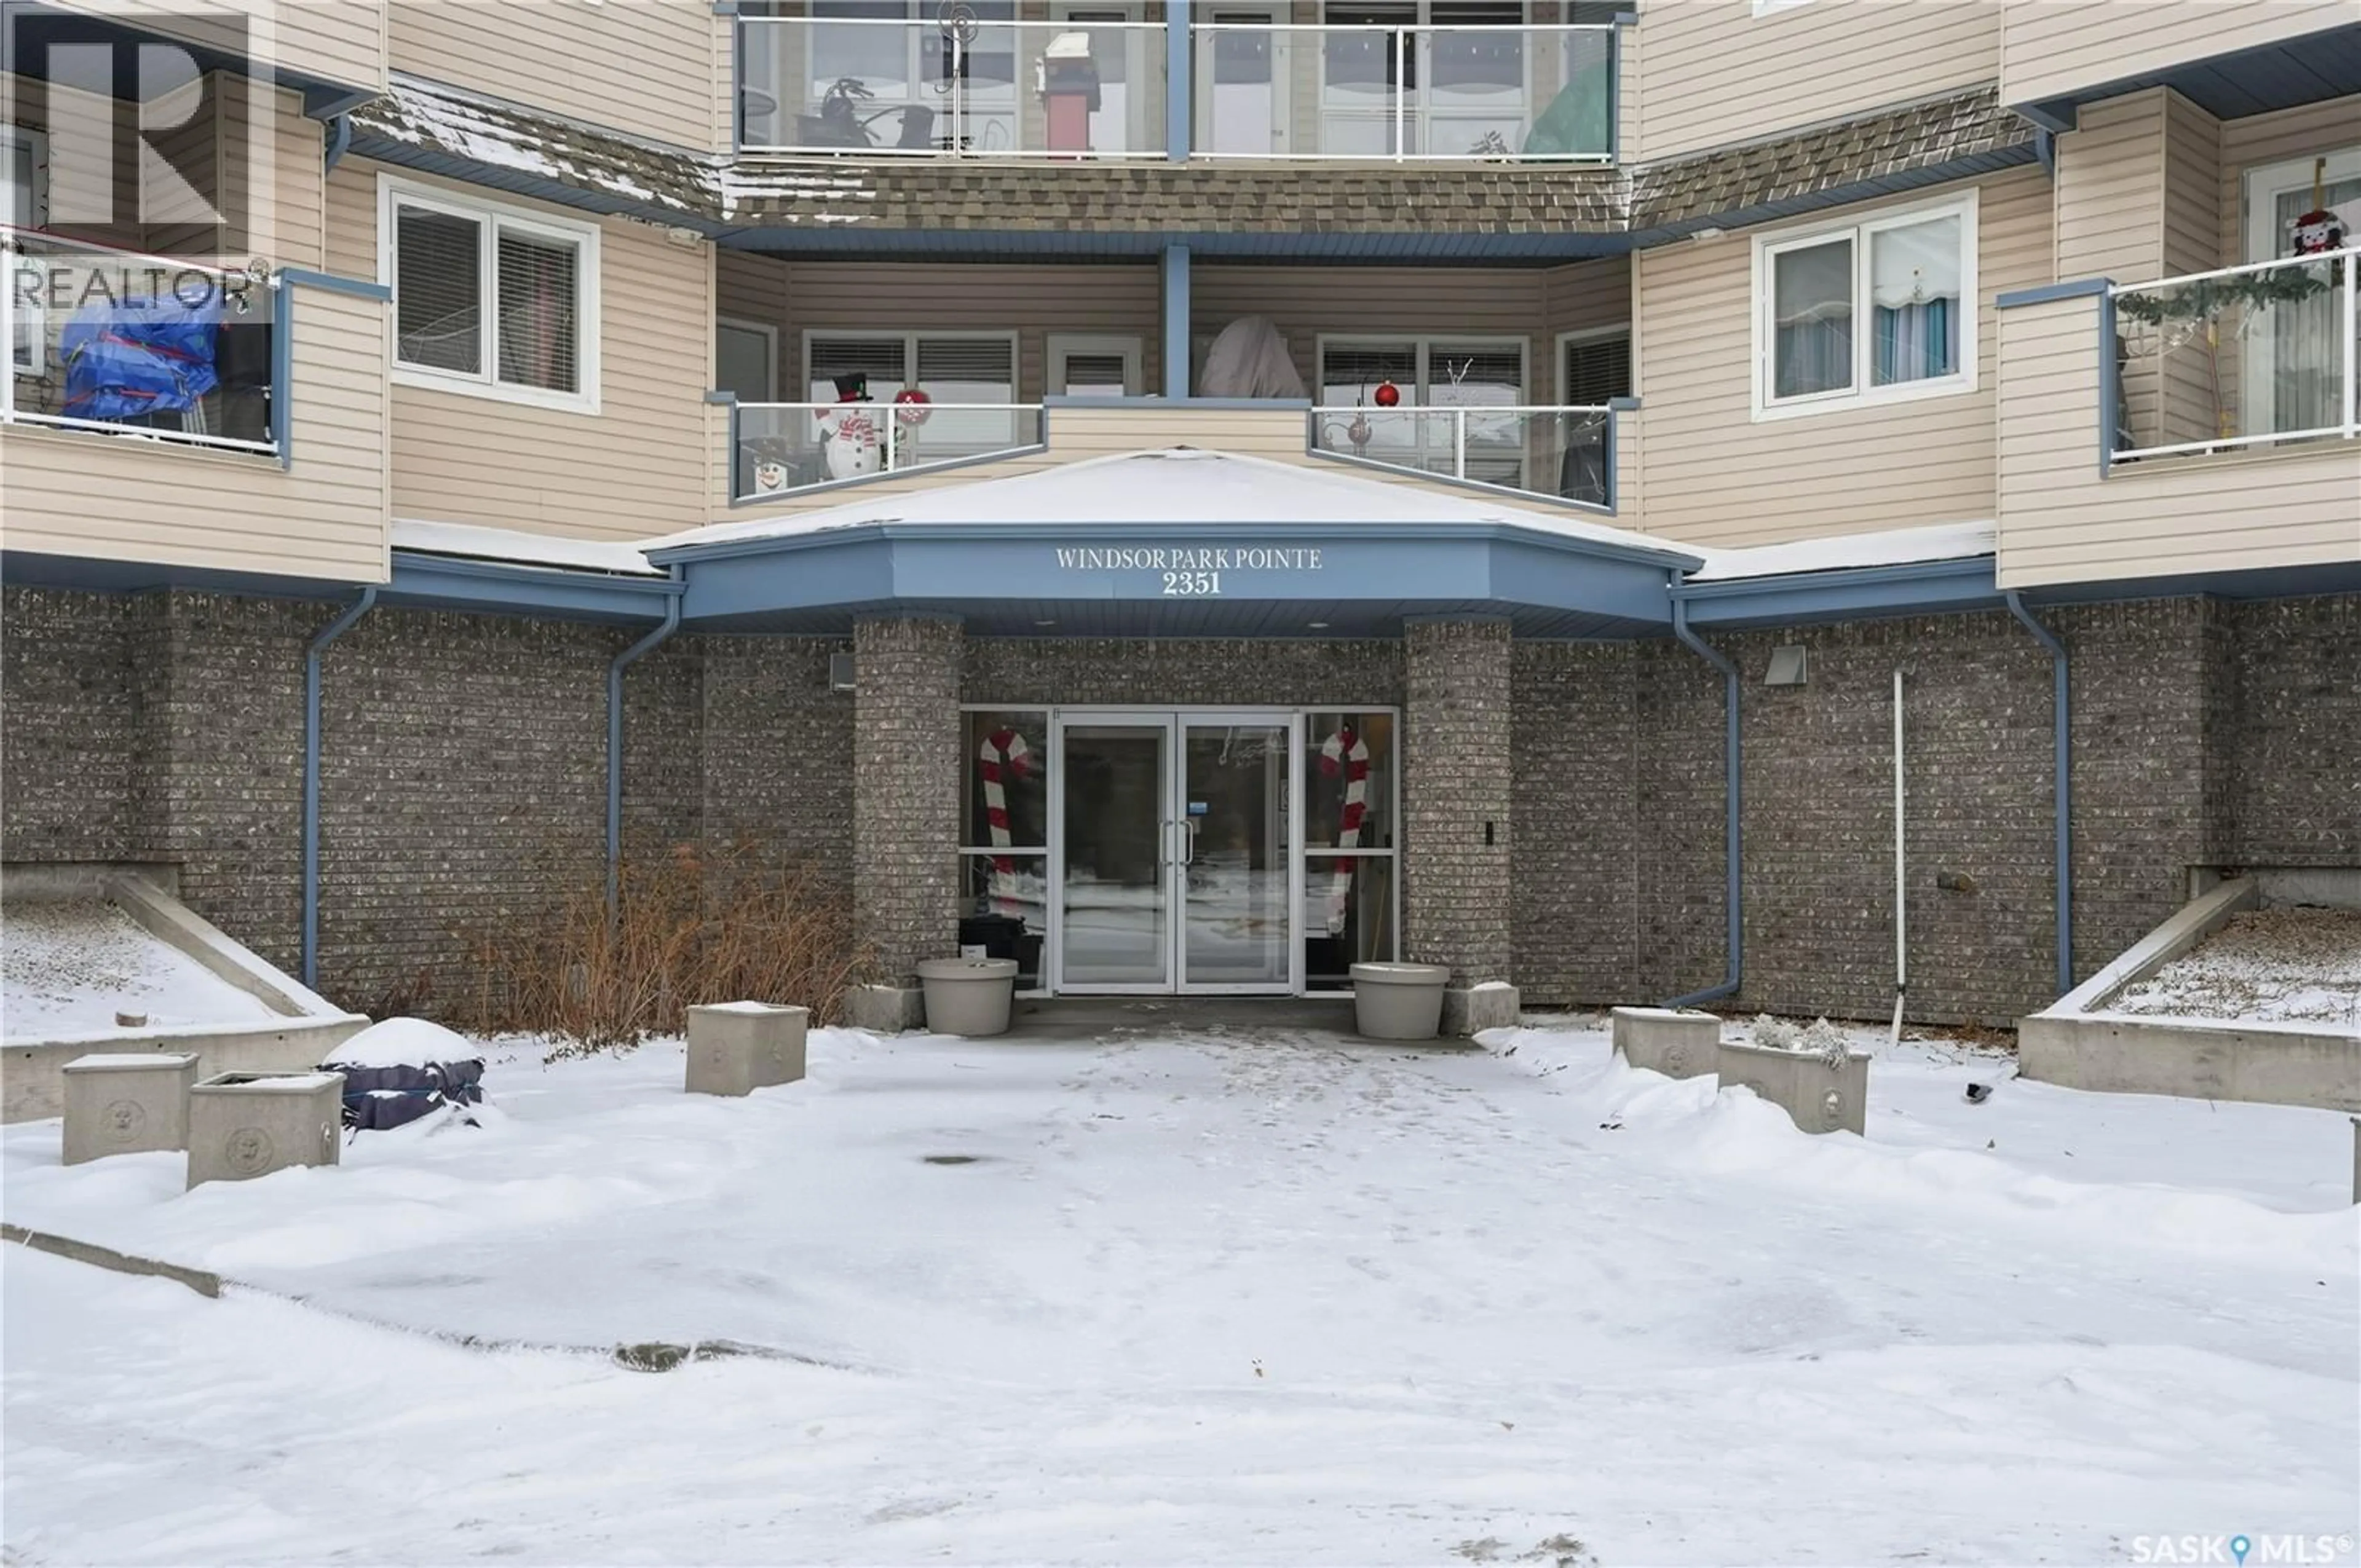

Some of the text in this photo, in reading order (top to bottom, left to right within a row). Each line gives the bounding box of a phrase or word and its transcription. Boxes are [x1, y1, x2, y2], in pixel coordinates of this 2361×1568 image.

[1056, 548, 1322, 569] WINDSOR PARK POINTE
[1163, 572, 1220, 595] 2351
